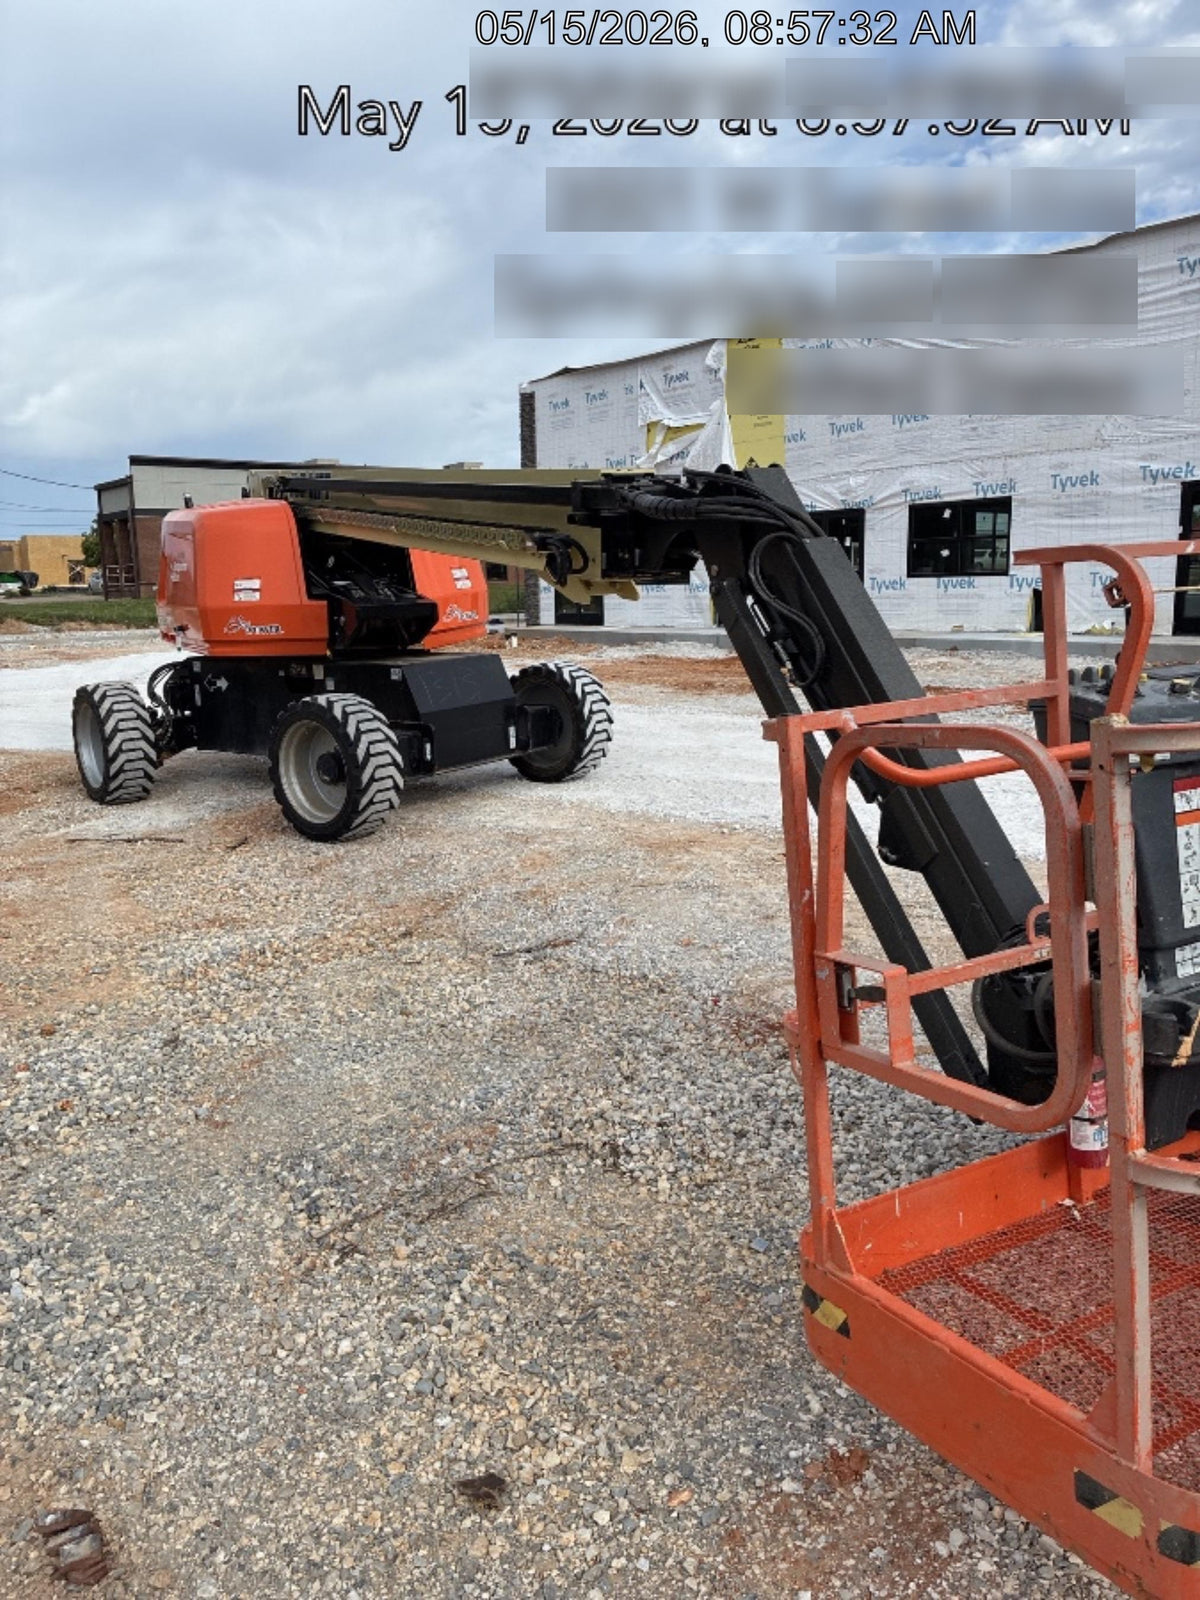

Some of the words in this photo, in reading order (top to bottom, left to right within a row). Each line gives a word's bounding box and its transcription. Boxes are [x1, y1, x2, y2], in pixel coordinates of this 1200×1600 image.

[828, 418, 865, 437] Tyvek
[972, 478, 1017, 497] Tyvek
[1050, 470, 1100, 492] Tyvek
[1139, 462, 1196, 485] Tyvek
[869, 576, 906, 594] Tyvek
[936, 576, 976, 593] Tyvek
[1009, 573, 1042, 592] Tyve
